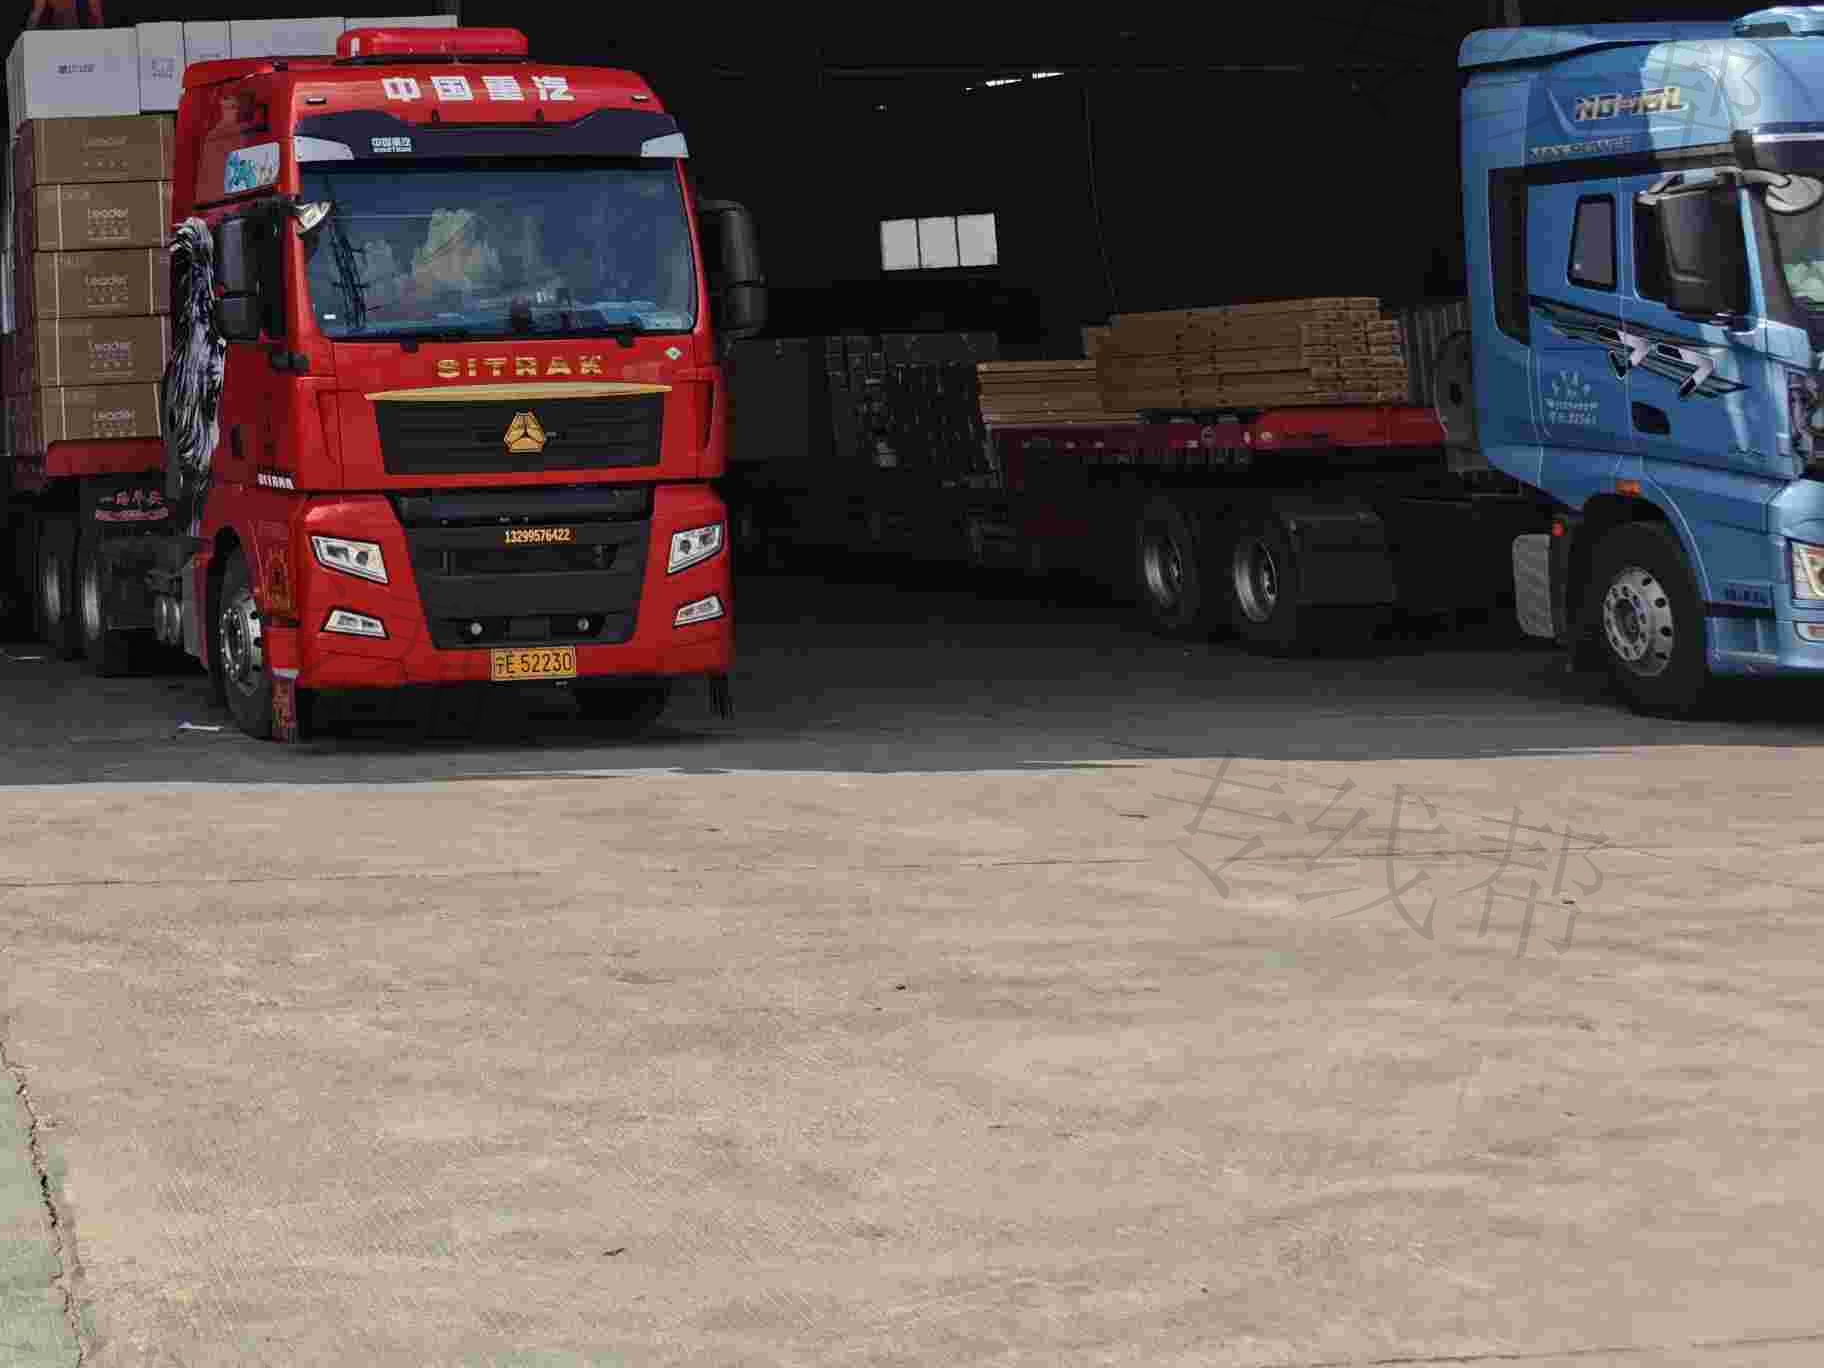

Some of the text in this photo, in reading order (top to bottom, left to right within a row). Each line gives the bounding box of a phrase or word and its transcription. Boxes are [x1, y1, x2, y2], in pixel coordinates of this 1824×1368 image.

[381, 74, 575, 103] 中国重汽
[434, 354, 604, 379] SITRAK
